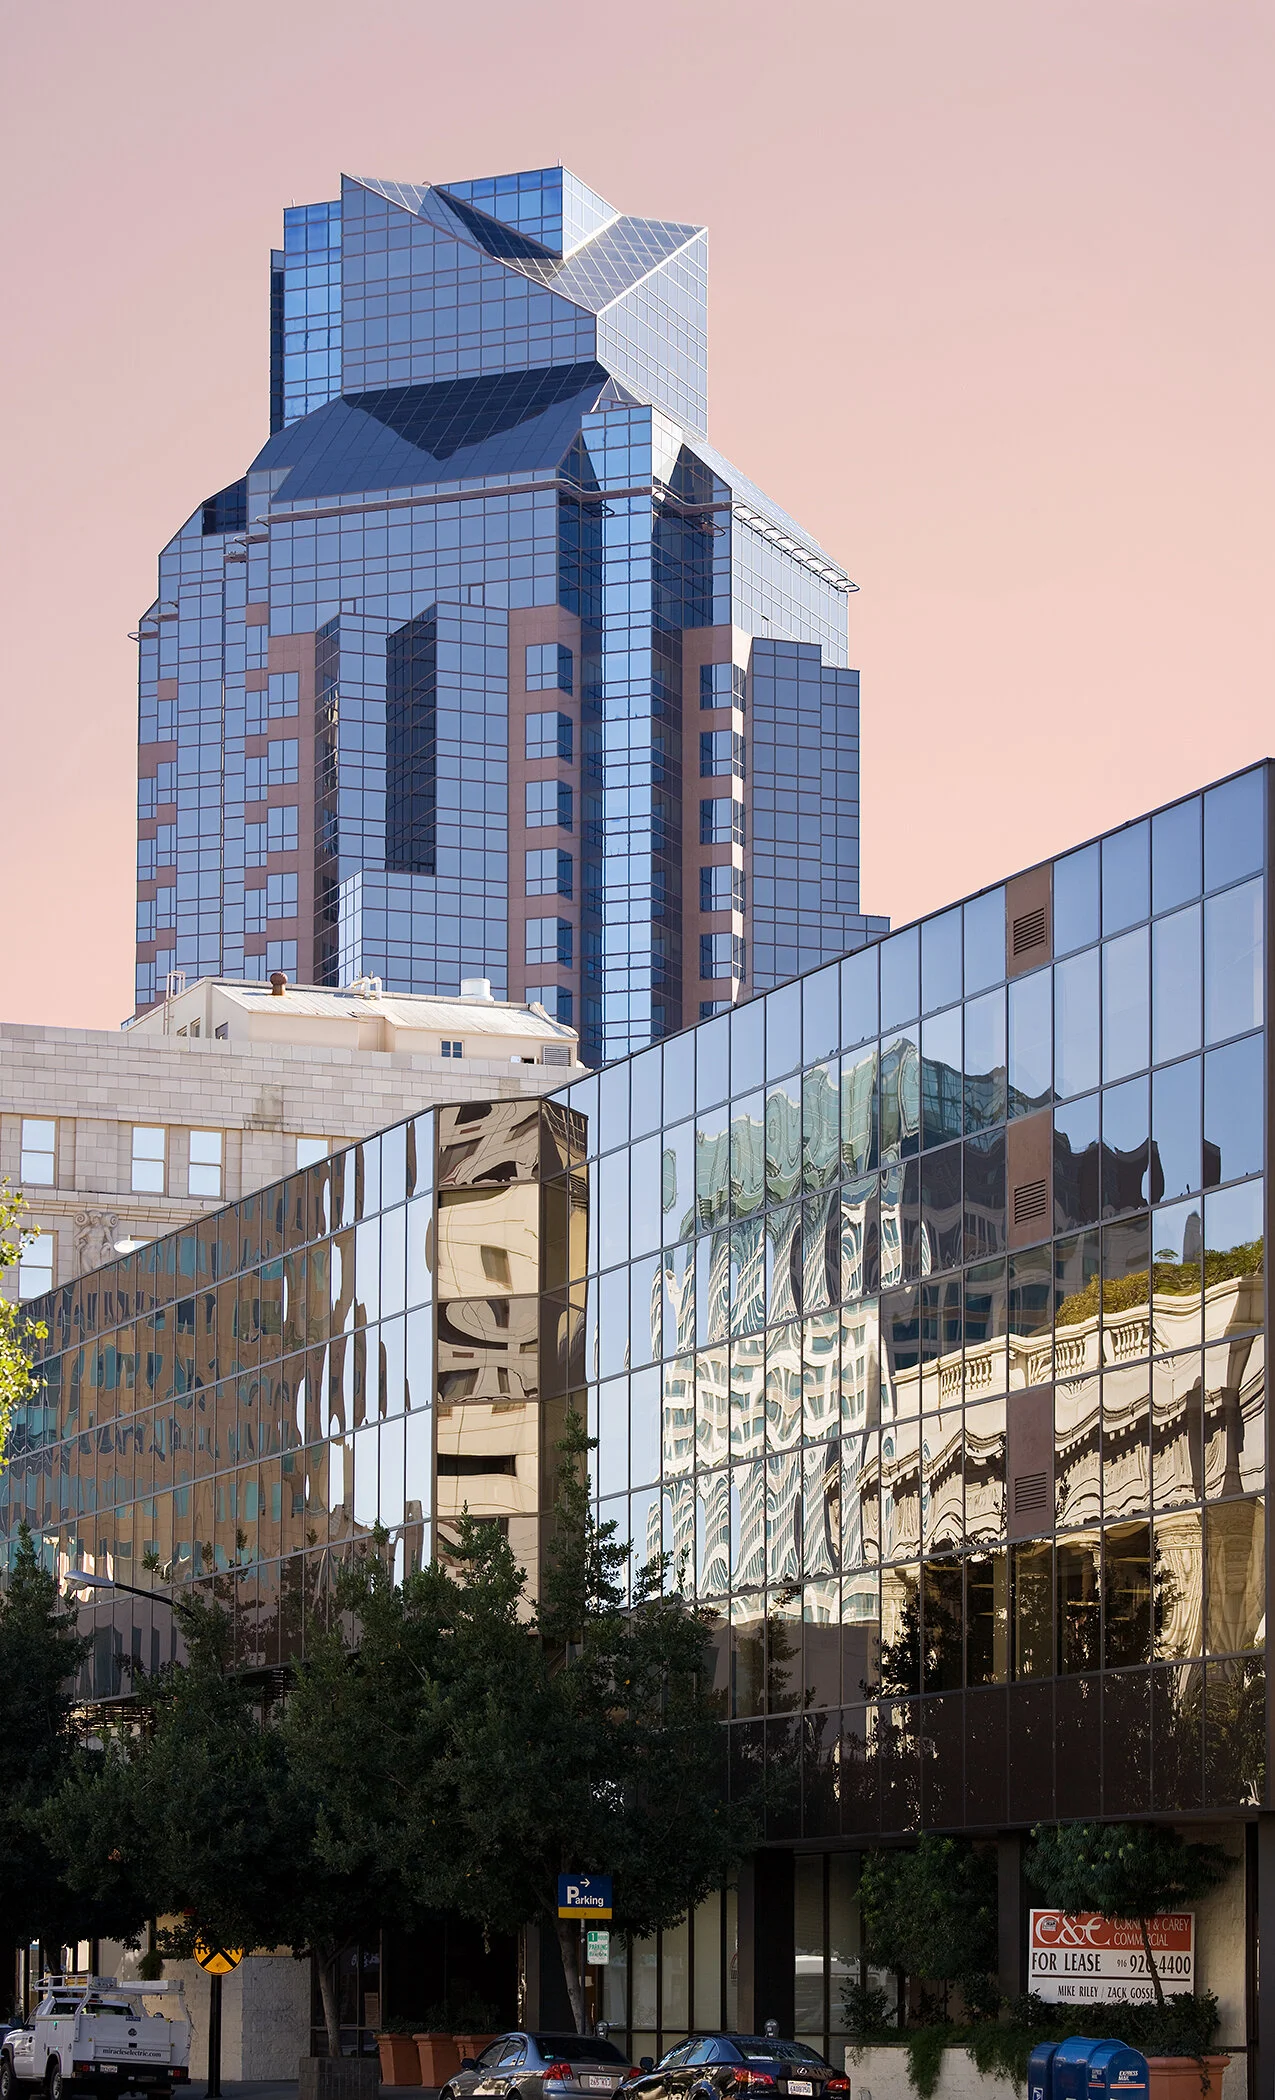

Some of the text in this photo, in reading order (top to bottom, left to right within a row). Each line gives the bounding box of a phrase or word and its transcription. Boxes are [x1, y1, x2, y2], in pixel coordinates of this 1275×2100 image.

[567, 1885, 604, 1907] Parking
[1153, 1918, 1160, 1930] &
[1162, 1918, 1189, 1931] CAREY
[1032, 1952, 1102, 1972] FOR LEASE
[1058, 1985, 1075, 1997] MIKE
[1079, 1986, 1098, 1998] RILEY
[1107, 1986, 1127, 1998] ZACK
[103, 2047, 162, 2058] miracleselectric.com
